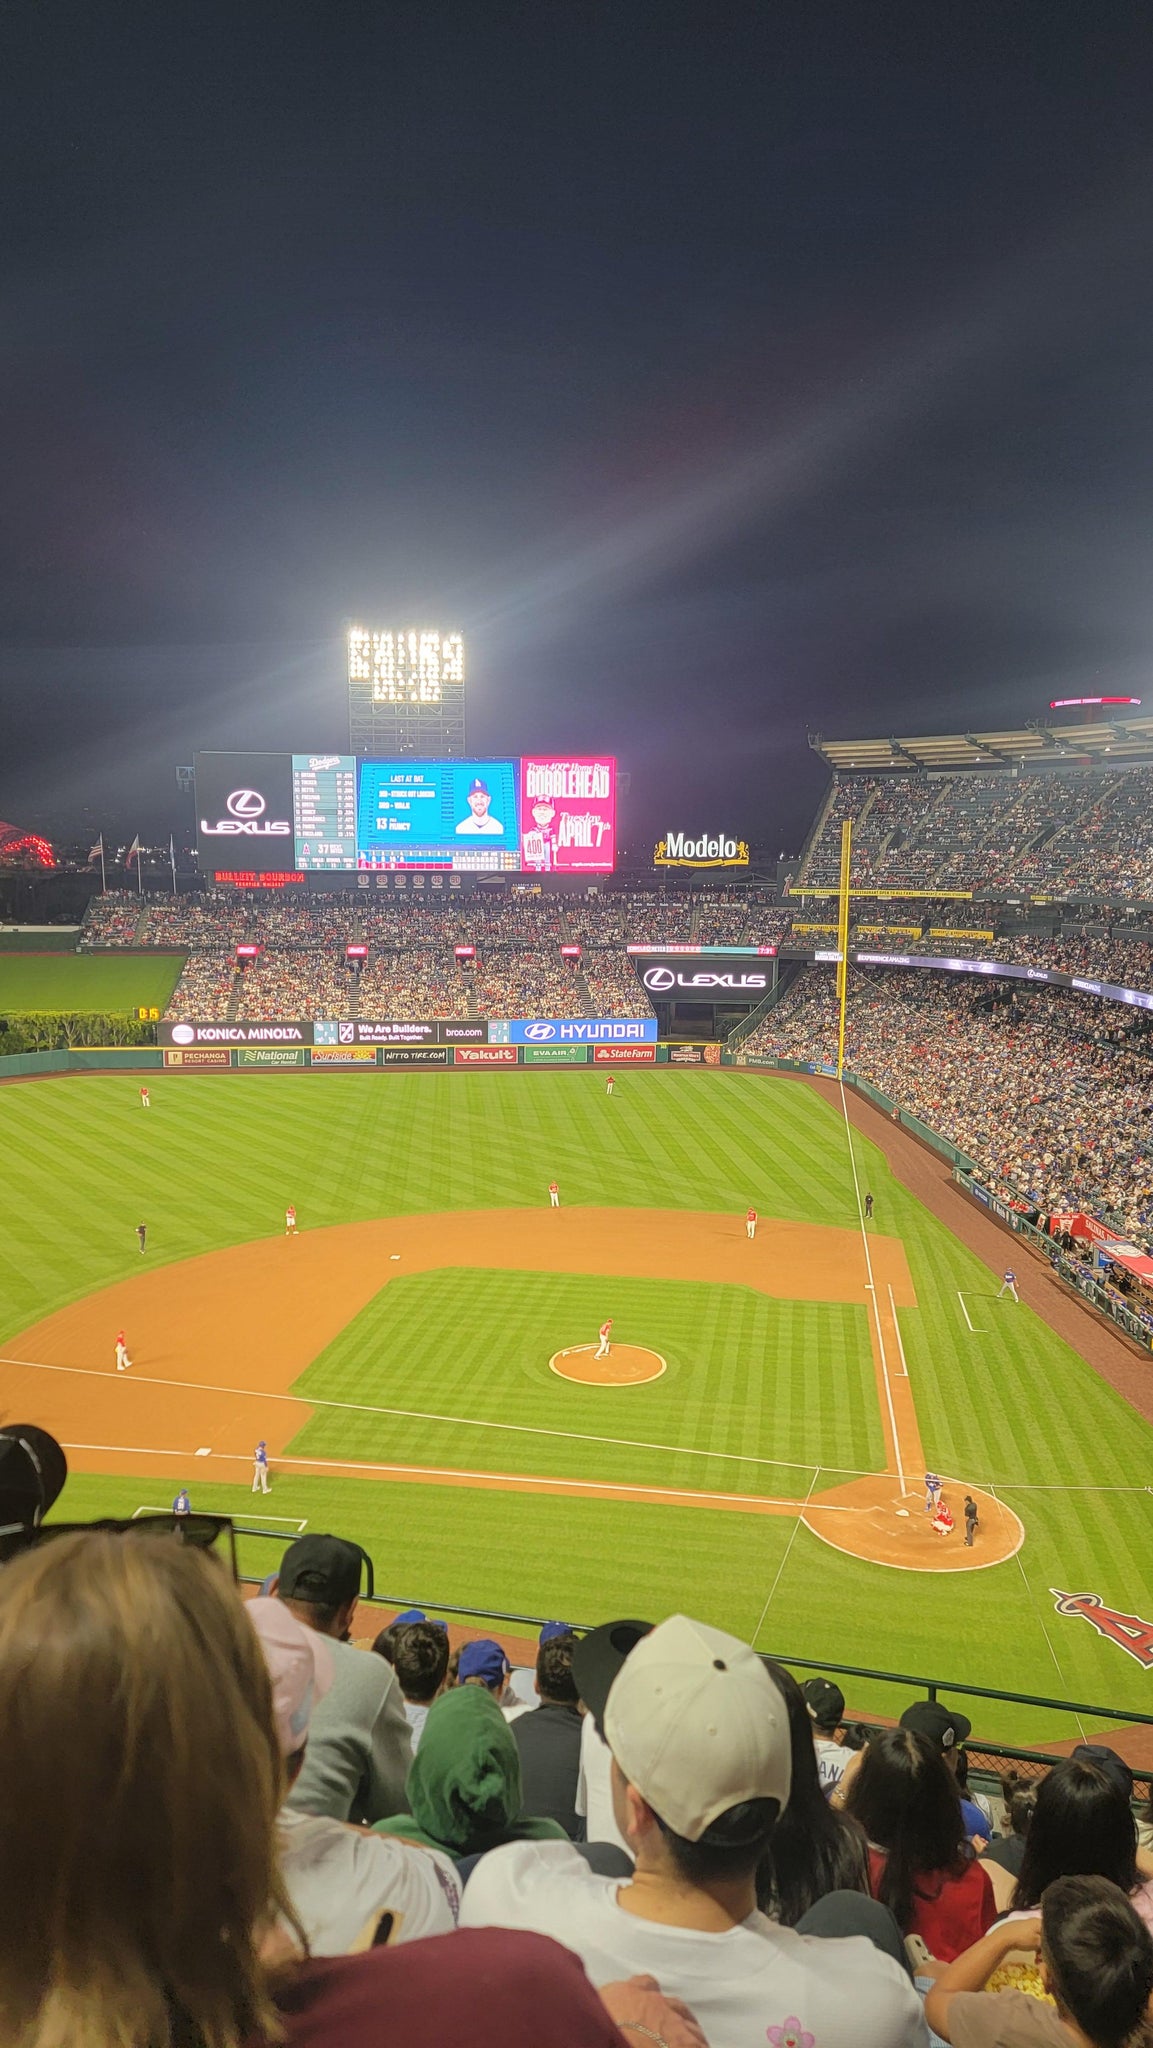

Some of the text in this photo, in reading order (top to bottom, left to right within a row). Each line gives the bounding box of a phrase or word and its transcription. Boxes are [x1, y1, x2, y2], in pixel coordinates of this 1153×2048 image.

[526, 770, 610, 798] BOBBLEHEAD
[376, 817, 387, 830] 13
[560, 811, 602, 826] Tuesday
[200, 820, 290, 835] LEXUS
[558, 821, 593, 847] APRIL
[527, 839, 543, 854] 400
[666, 832, 737, 858] Modelo
[259, 872, 305, 882] BOURBON
[677, 974, 767, 988] LEXUS
[197, 1028, 303, 1040] KONICA MINOLTA
[358, 1024, 432, 1033] We Are Builders.
[446, 1028, 483, 1037] brco.com
[560, 1024, 645, 1039] HYUNDAI
[256, 1051, 298, 1061] National
[314, 1051, 352, 1061] Surfside
[386, 1051, 446, 1060] NITTO TIRE.COM
[459, 1050, 514, 1060] Yakult
[610, 1050, 653, 1058] State Farm
